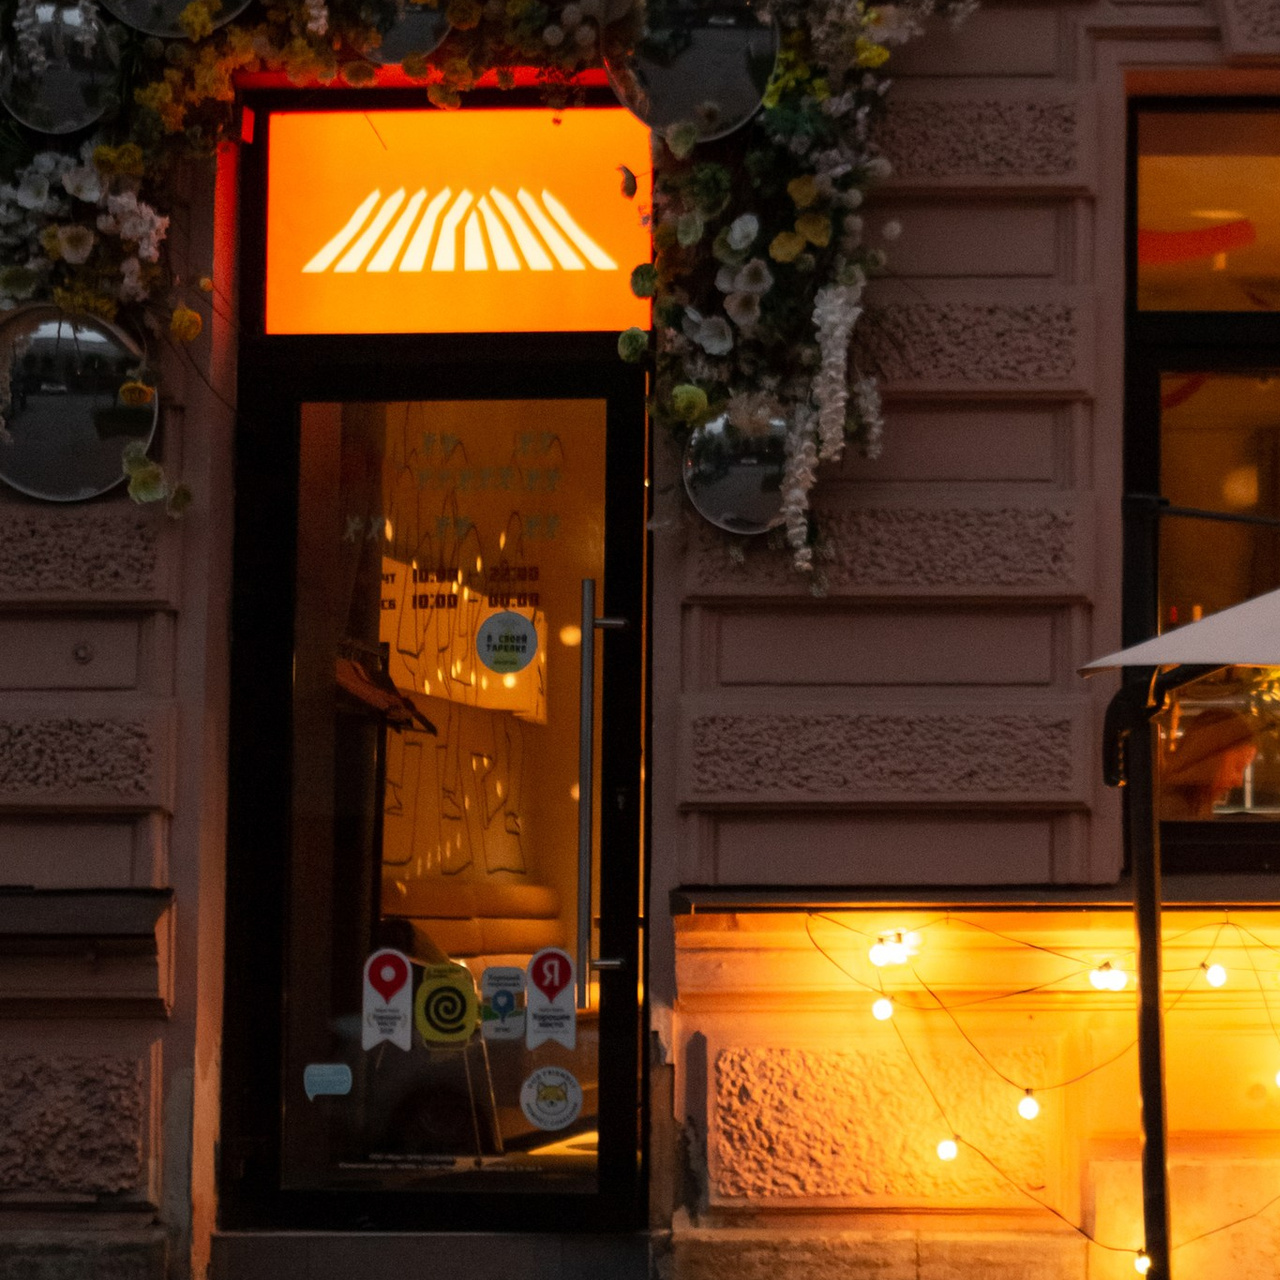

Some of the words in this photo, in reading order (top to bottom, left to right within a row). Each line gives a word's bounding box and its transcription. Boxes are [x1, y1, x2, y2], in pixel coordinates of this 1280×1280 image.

[412, 594, 458, 609] 10:00
[488, 593, 540, 608] 00:00
[498, 633, 528, 644] СВОЕЙ
[486, 644, 527, 653] ТАРЕЛКЕ
[542, 959, 560, 987] Я
[532, 1013, 571, 1022] Хорошее
